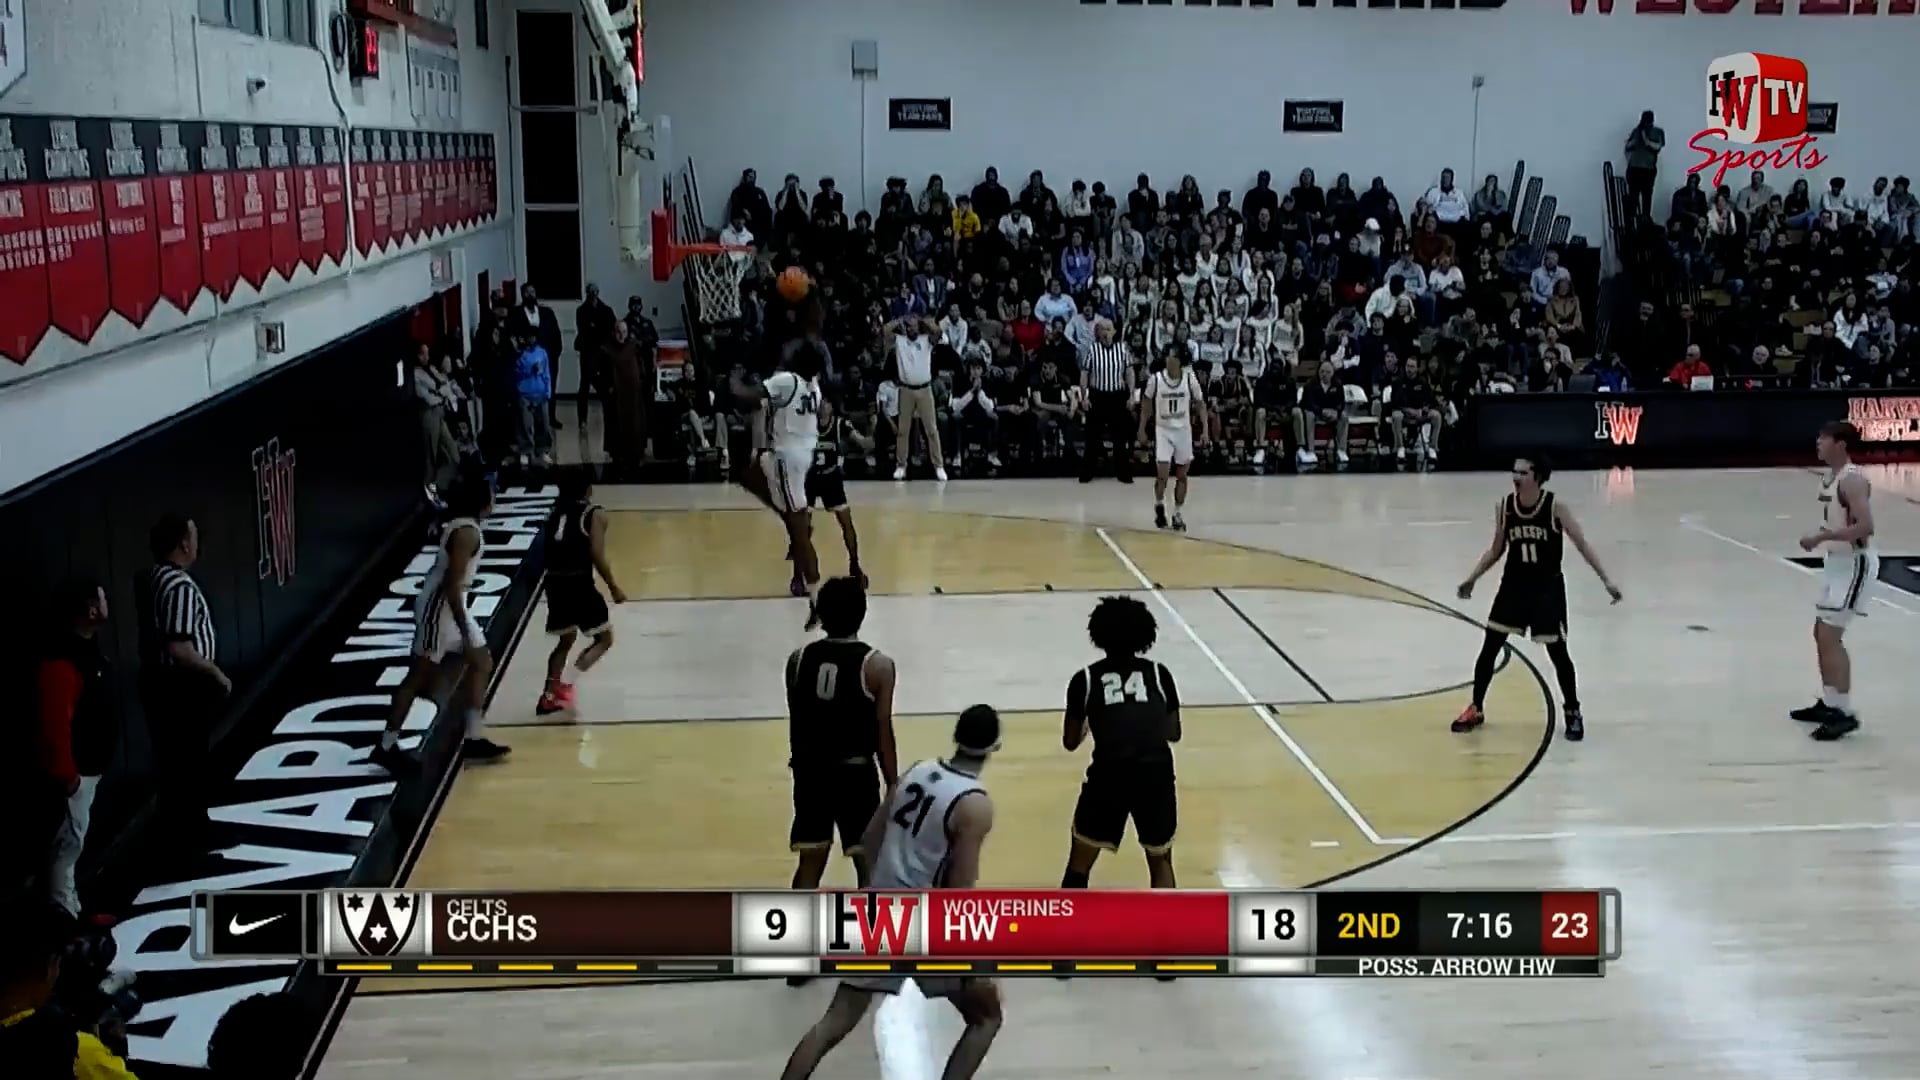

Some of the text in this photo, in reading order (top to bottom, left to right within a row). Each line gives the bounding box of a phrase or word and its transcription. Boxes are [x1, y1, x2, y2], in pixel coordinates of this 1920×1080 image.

[1594, 401, 1644, 446] HW
[1521, 543, 1539, 565] 11
[817, 662, 839, 700] 0
[1101, 672, 1148, 704] 24
[894, 783, 936, 838] 21
